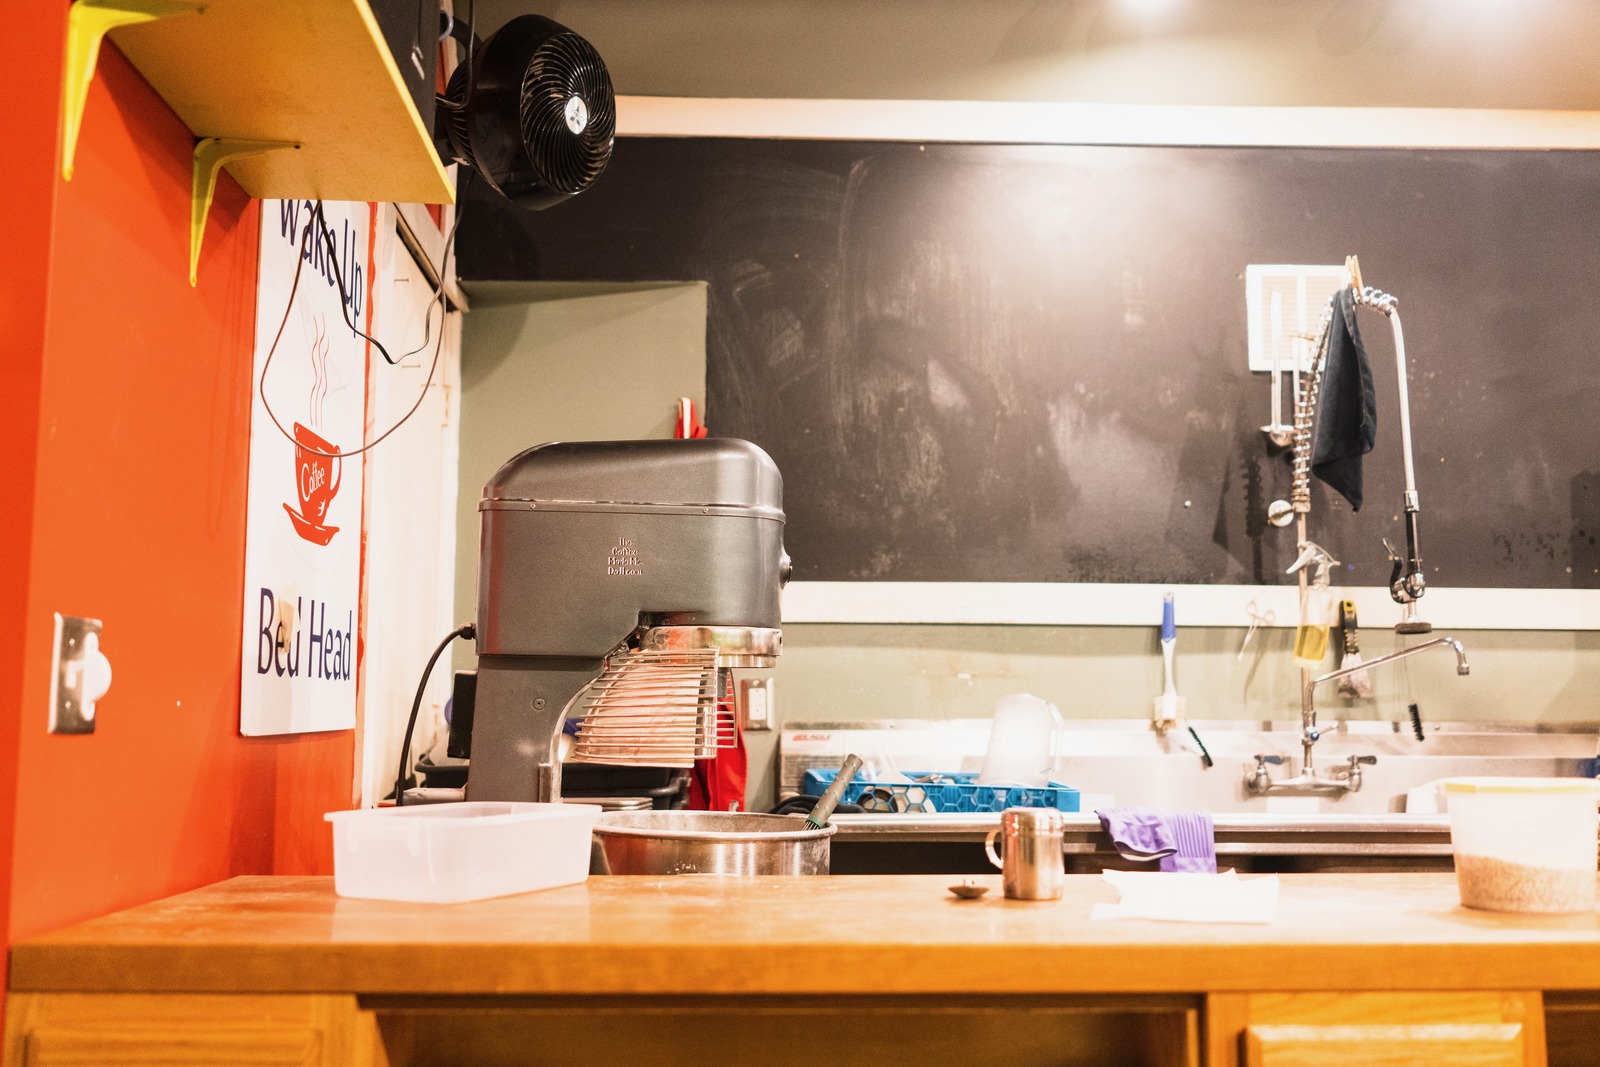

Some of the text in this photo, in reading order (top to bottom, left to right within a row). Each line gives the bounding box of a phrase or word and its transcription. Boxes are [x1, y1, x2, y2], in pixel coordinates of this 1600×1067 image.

[343, 218, 363, 339] Up
[301, 461, 325, 502] Coffee
[611, 546, 639, 556] Coffee
[618, 537, 633, 546] The
[257, 587, 352, 681] Bed Head
